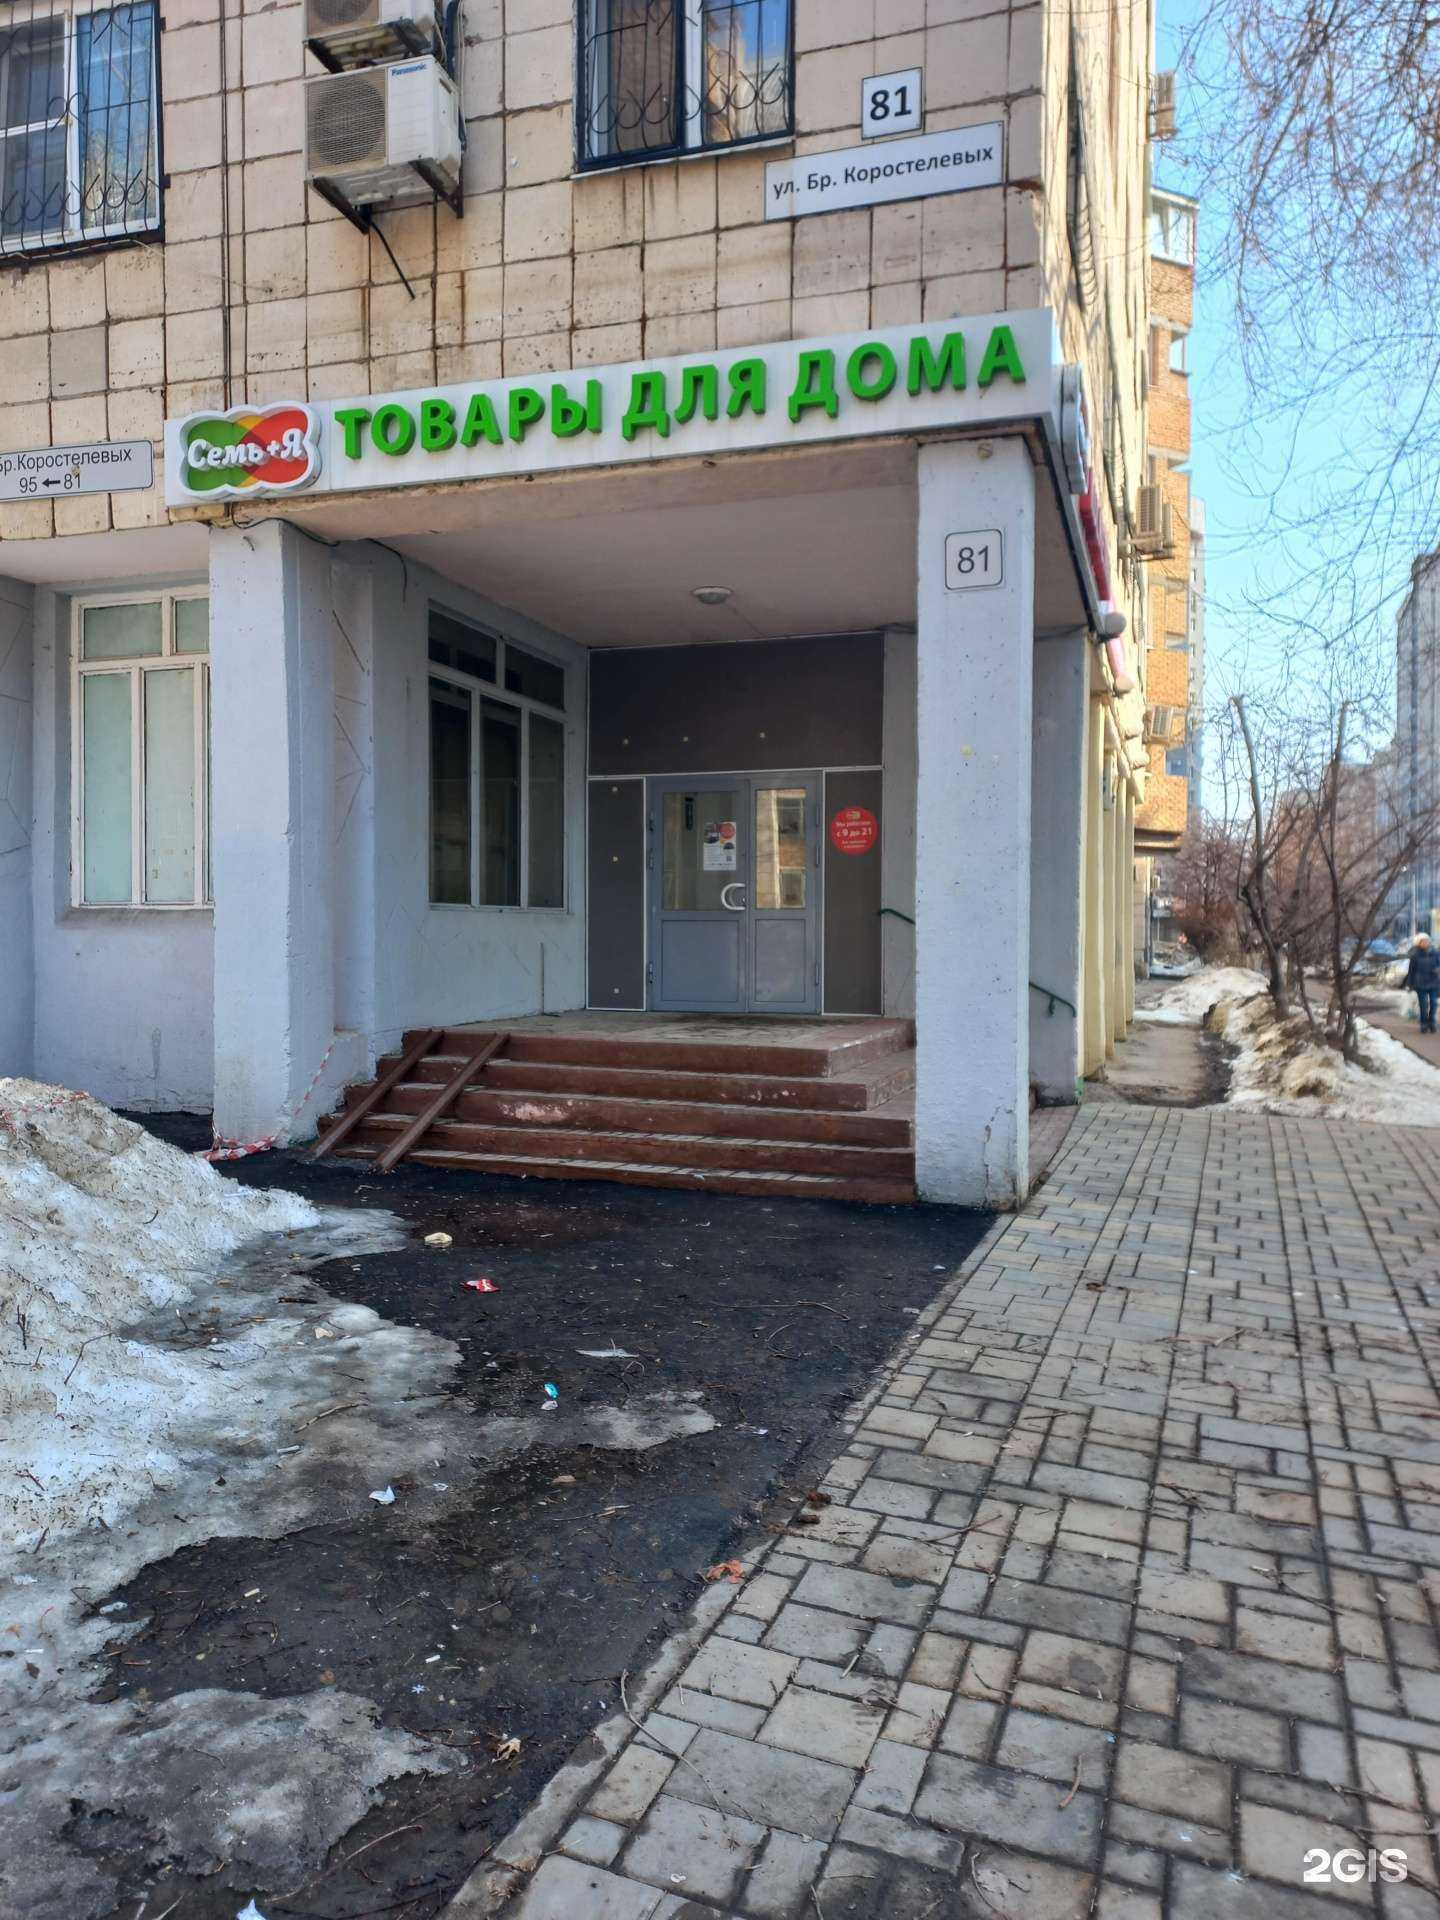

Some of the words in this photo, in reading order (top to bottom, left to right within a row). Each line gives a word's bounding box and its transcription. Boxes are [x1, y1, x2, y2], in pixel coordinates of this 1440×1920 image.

[391, 63, 427, 77] Panasonic
[869, 85, 913, 121] 81
[773, 179, 801, 200] ул.
[807, 173, 838, 192] Бр.
[844, 146, 994, 184] Коростелевых
[334, 379, 603, 461] ТОВАРЫ
[621, 358, 767, 442] ДЛЯ
[788, 325, 1027, 424] ДОМА
[19, 476, 38, 494] 95
[63, 472, 81, 490] 81
[957, 545, 989, 574] 81
[842, 828, 849, 837] 9
[862, 827, 872, 837] 21
